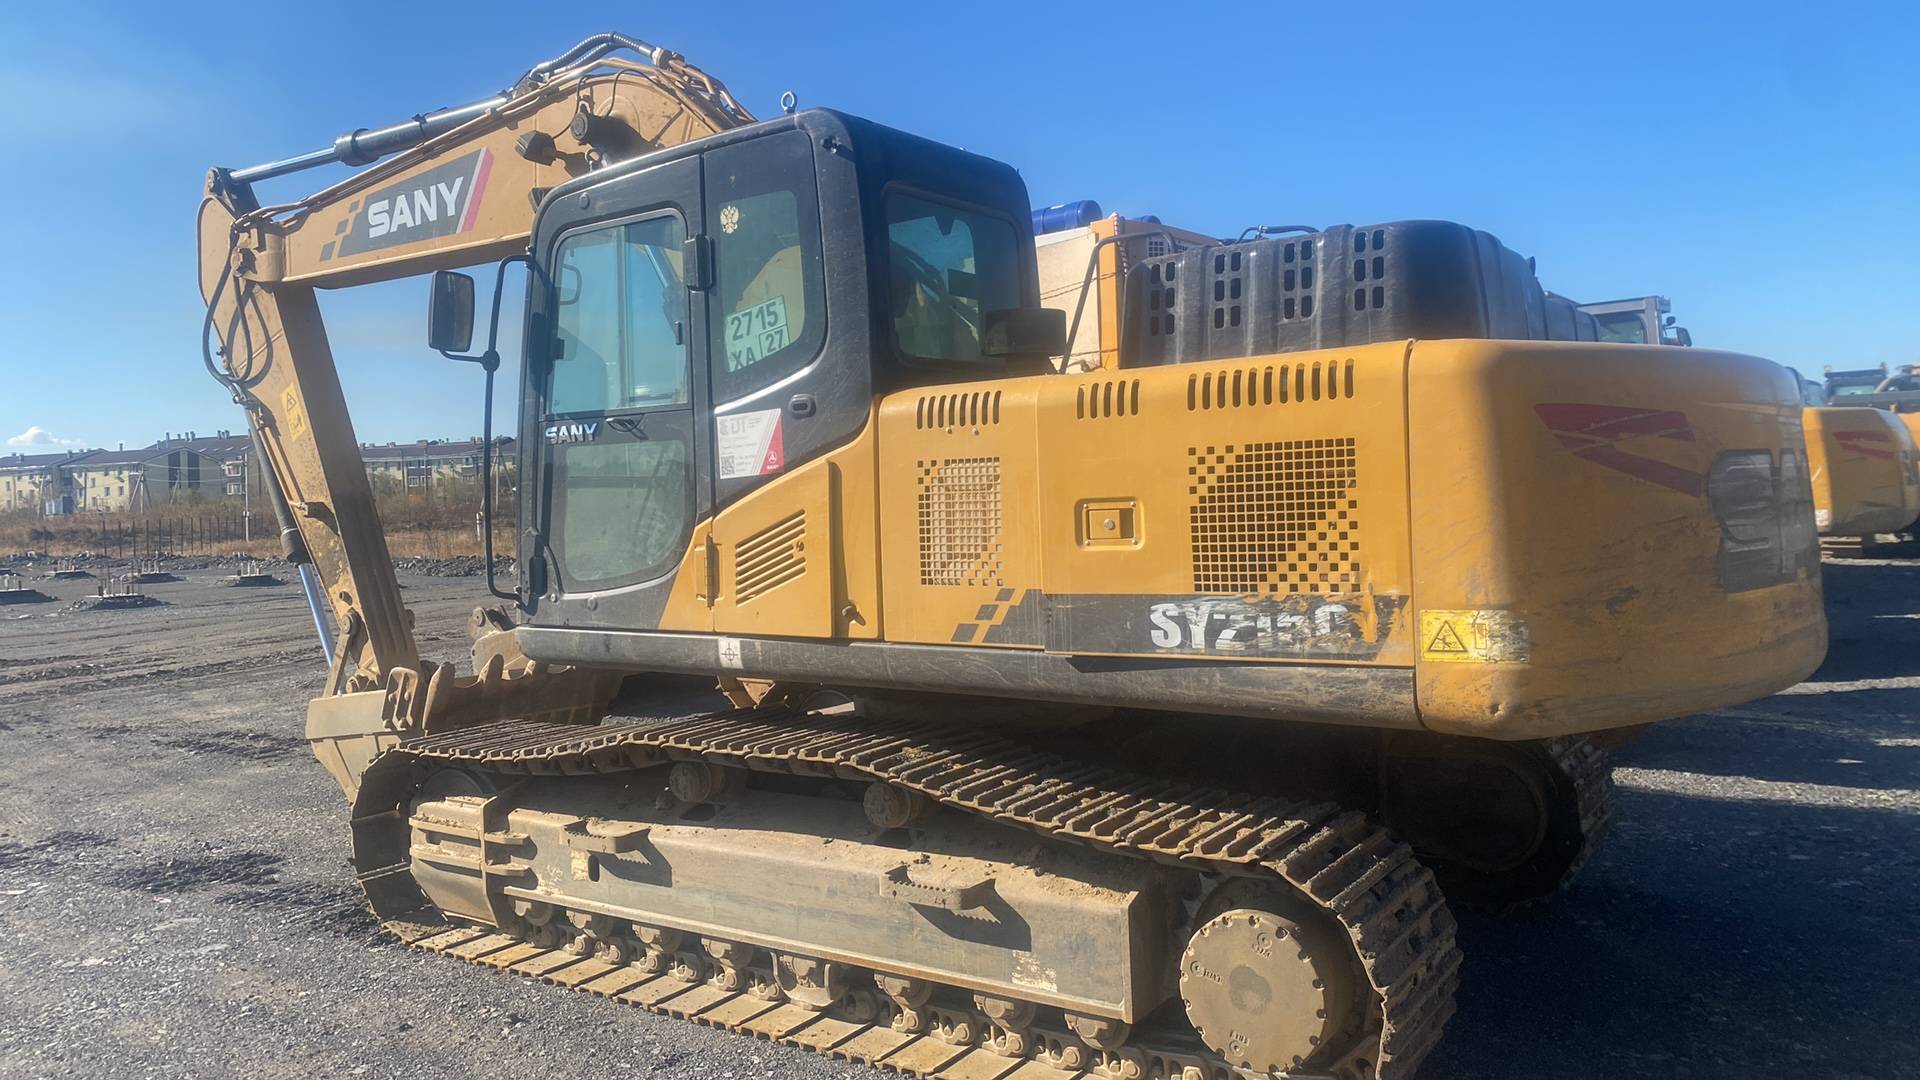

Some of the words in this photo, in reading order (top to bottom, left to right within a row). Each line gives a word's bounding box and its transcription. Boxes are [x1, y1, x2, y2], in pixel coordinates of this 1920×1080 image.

[368, 176, 464, 239] SANY
[730, 301, 779, 342] 2715
[765, 329, 784, 354] 27
[545, 423, 598, 445] SANY
